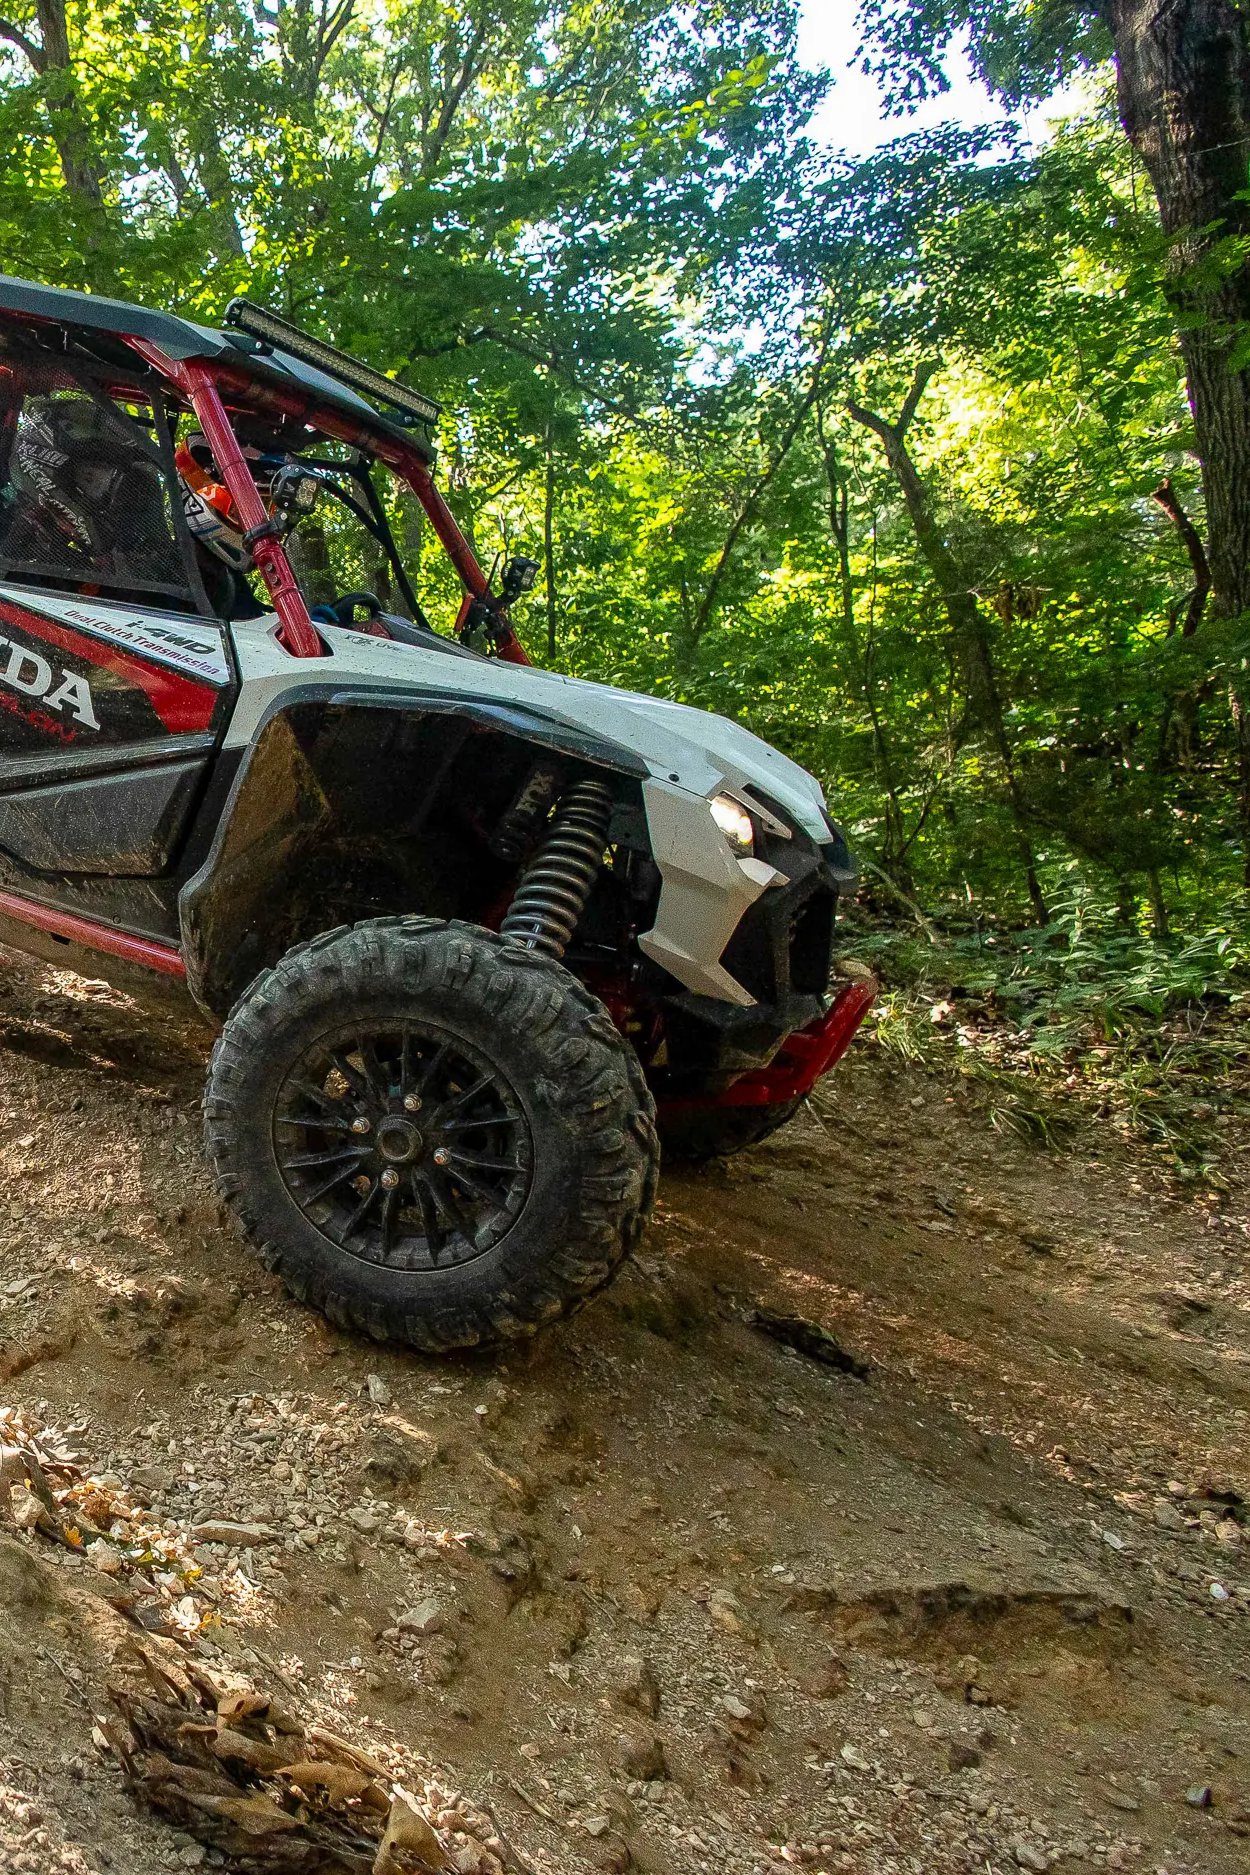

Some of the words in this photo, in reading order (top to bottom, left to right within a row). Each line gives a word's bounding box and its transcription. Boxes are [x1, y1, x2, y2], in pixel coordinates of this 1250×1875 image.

[64, 610, 93, 625] Dual
[92, 621, 133, 641] Clutch
[132, 635, 220, 674] Transmission
[125, 621, 216, 655] i-4WD
